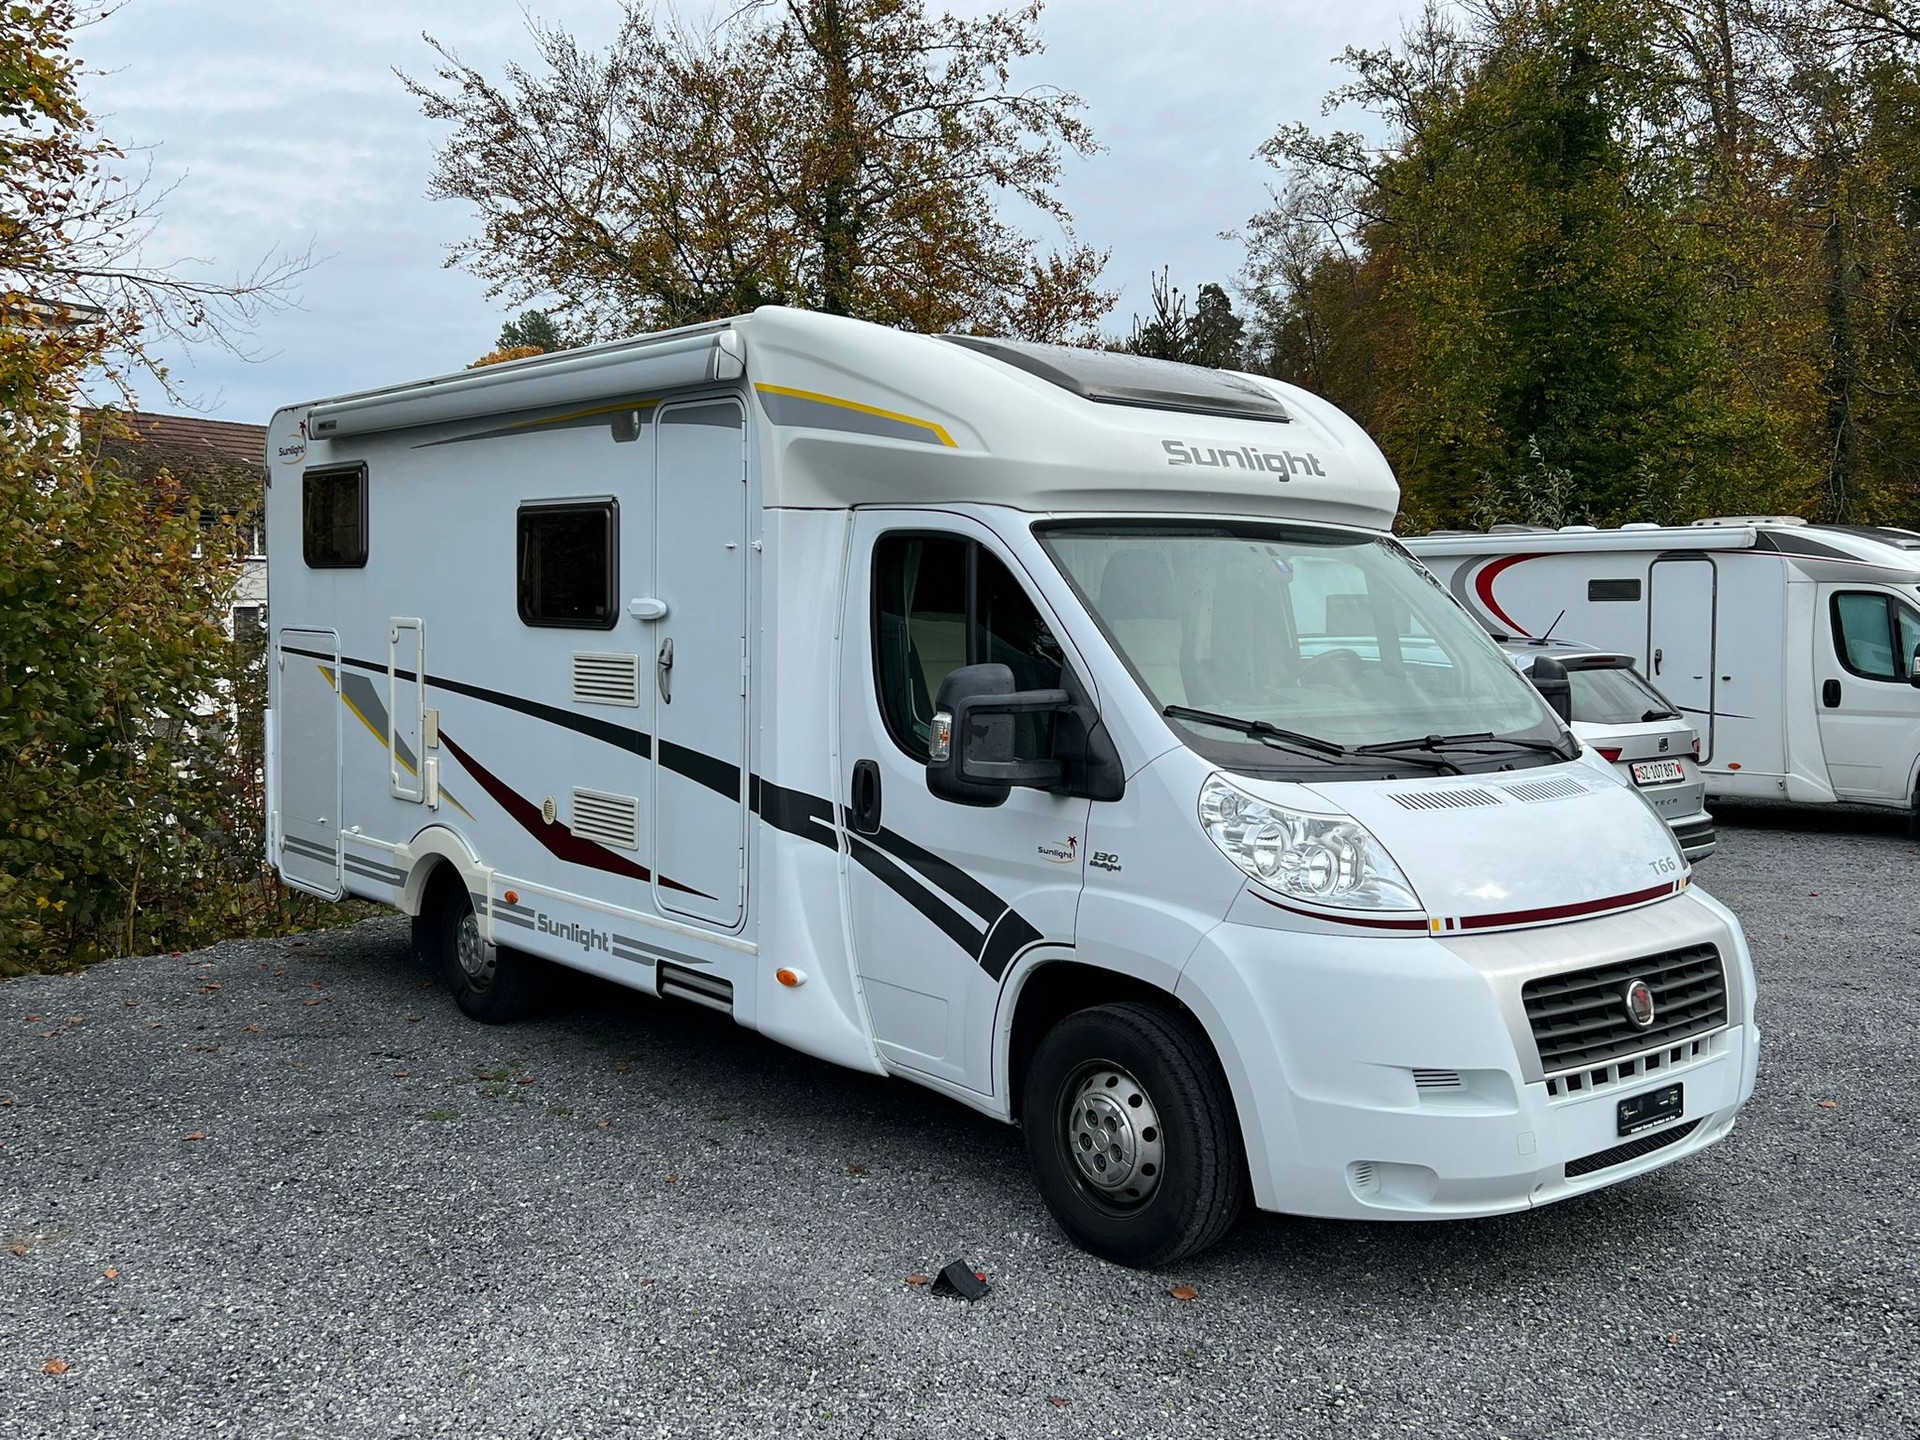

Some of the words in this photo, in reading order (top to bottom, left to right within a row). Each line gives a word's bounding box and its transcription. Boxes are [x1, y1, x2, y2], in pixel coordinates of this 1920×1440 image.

[278, 444, 305, 457] Sunlight
[1161, 440, 1326, 482] Sunlight
[1037, 846, 1073, 859] Sunlight
[1648, 856, 1676, 875] T66
[537, 912, 609, 952] Sunlight
